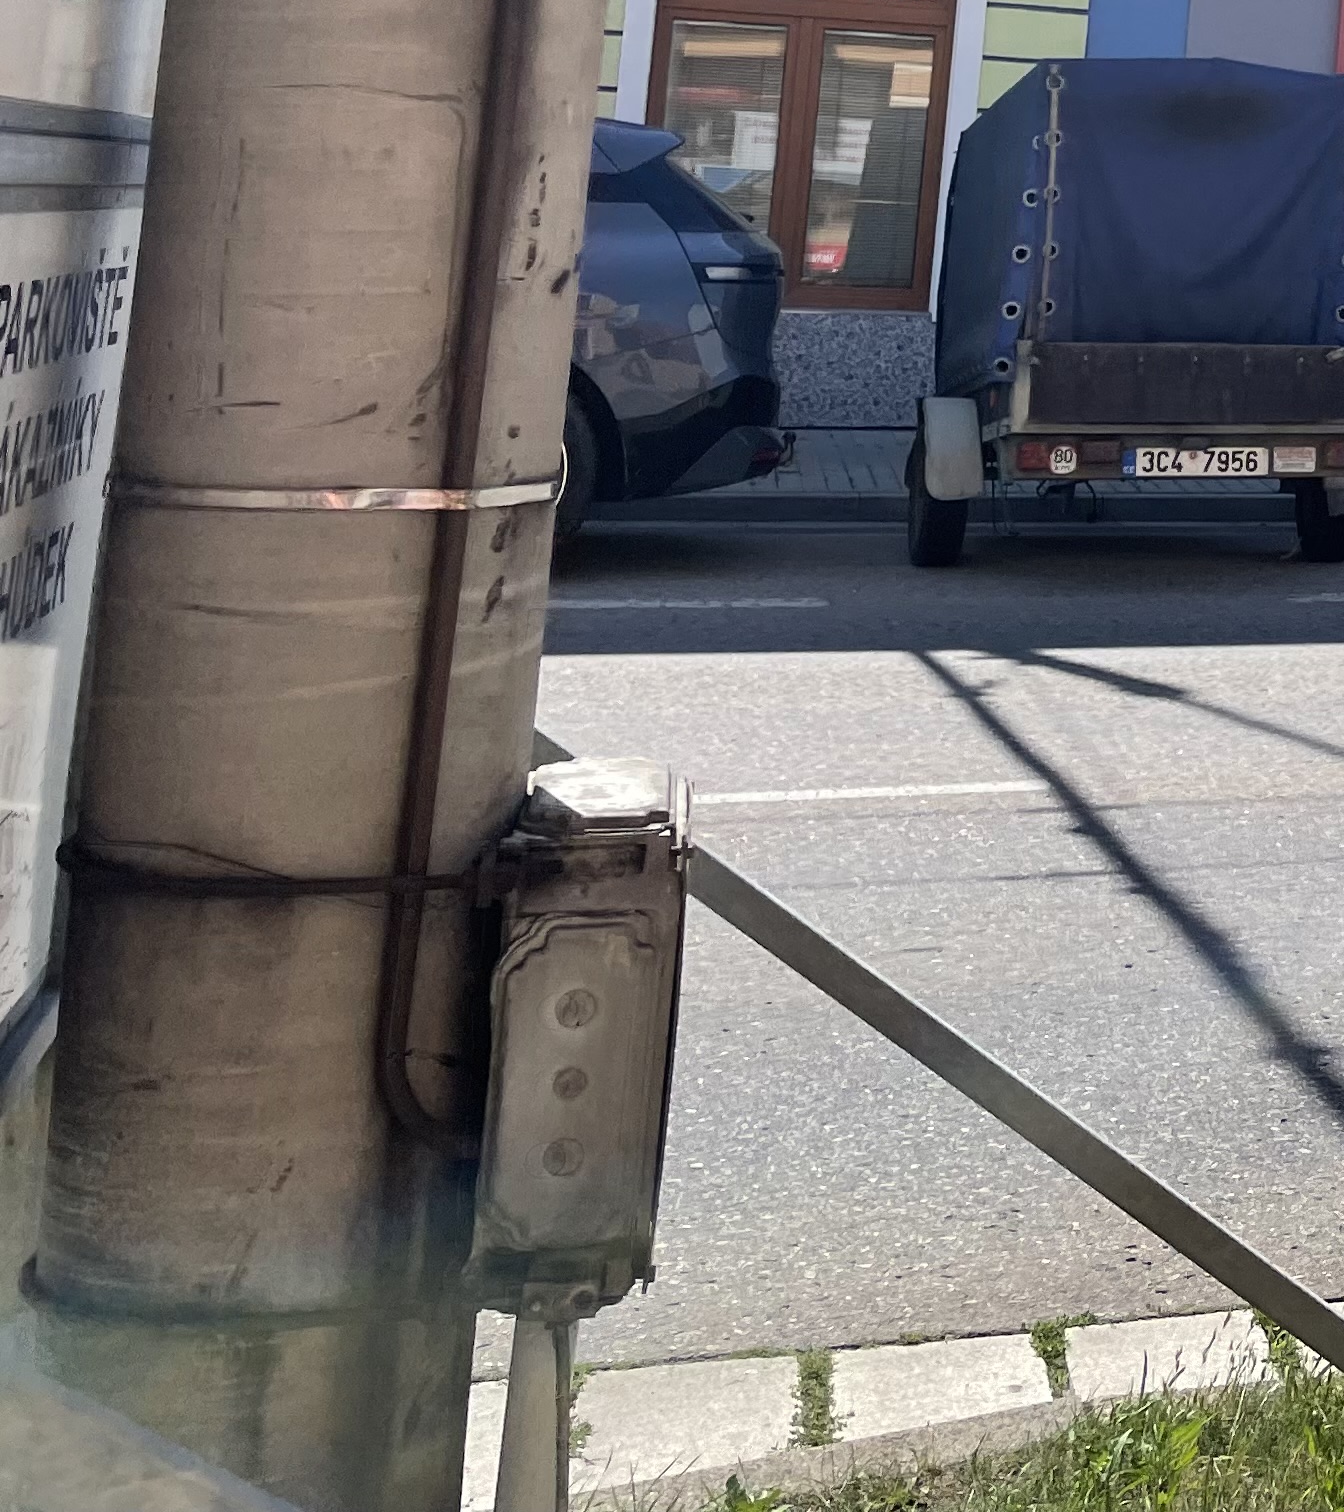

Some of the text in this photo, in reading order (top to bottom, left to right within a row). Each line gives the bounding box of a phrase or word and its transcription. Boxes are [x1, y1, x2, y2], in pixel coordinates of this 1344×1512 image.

[1053, 448, 1073, 464] 80
[1141, 449, 1184, 473] 3C4
[1203, 449, 1259, 473] 7956
